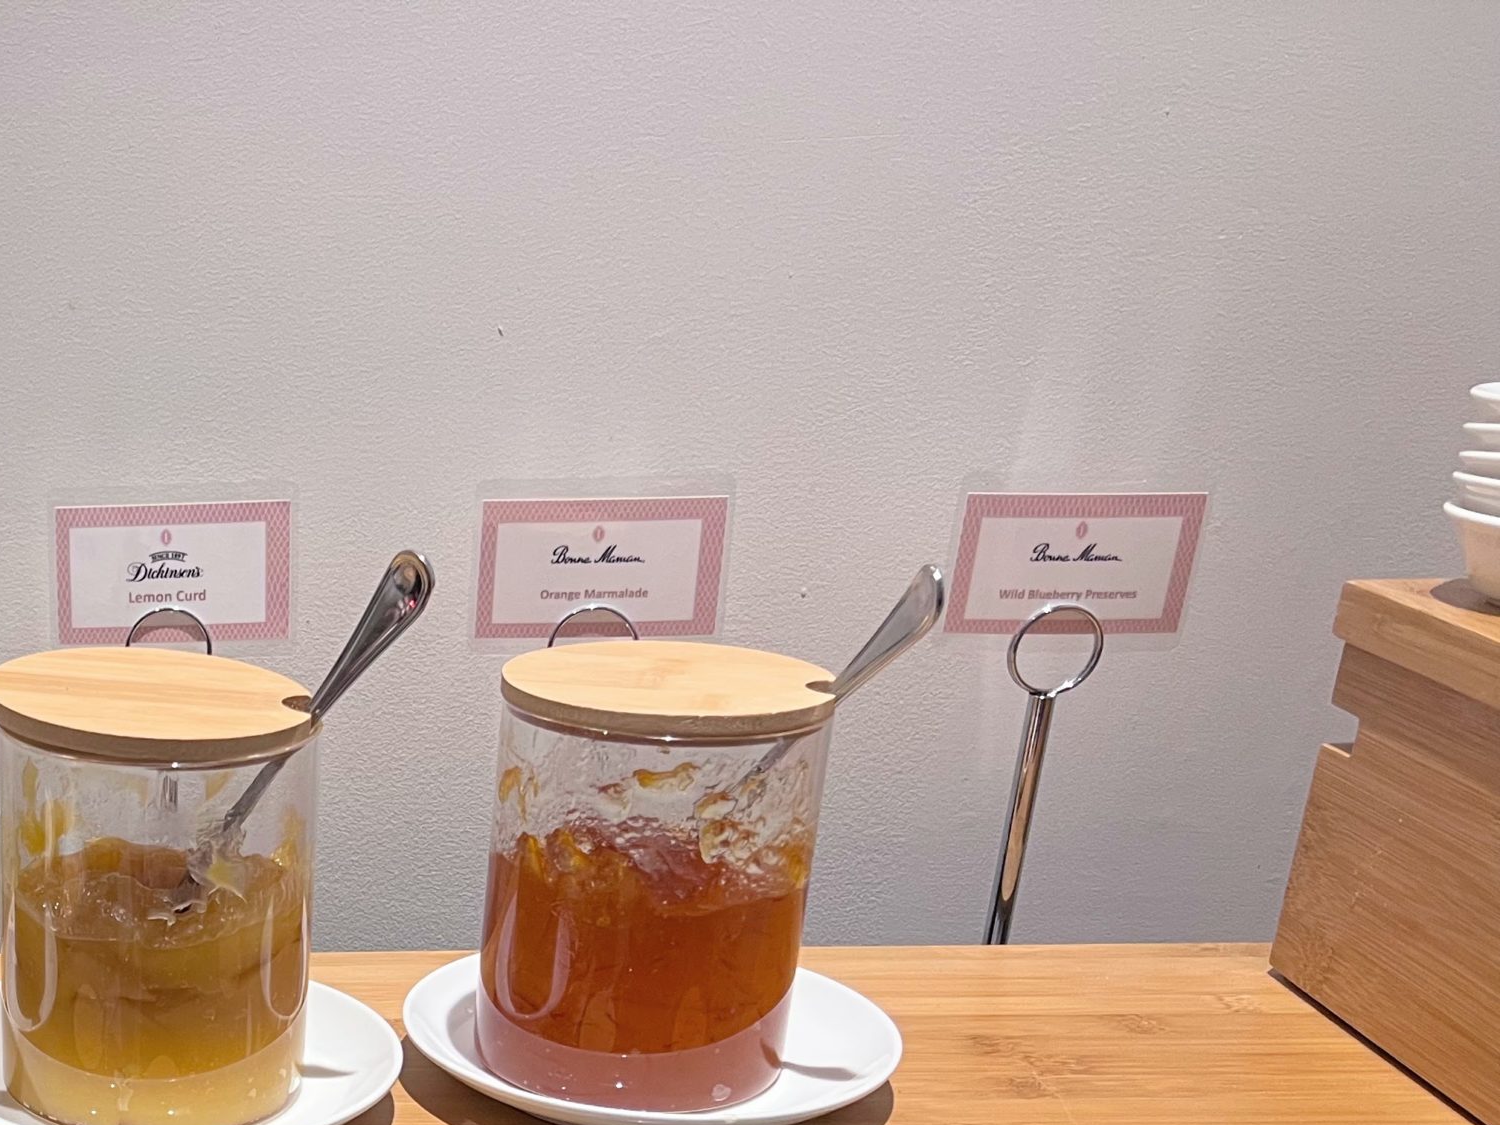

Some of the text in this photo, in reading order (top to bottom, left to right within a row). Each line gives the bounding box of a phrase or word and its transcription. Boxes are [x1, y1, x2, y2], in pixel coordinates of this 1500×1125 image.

[549, 544, 645, 564] Bonne Maman
[1030, 543, 1123, 562] Bonne Maman
[128, 589, 206, 603] Lemon Curd
[540, 587, 649, 601] Orange Marmalade
[999, 589, 1138, 601] Wild Blueberry Preserves
